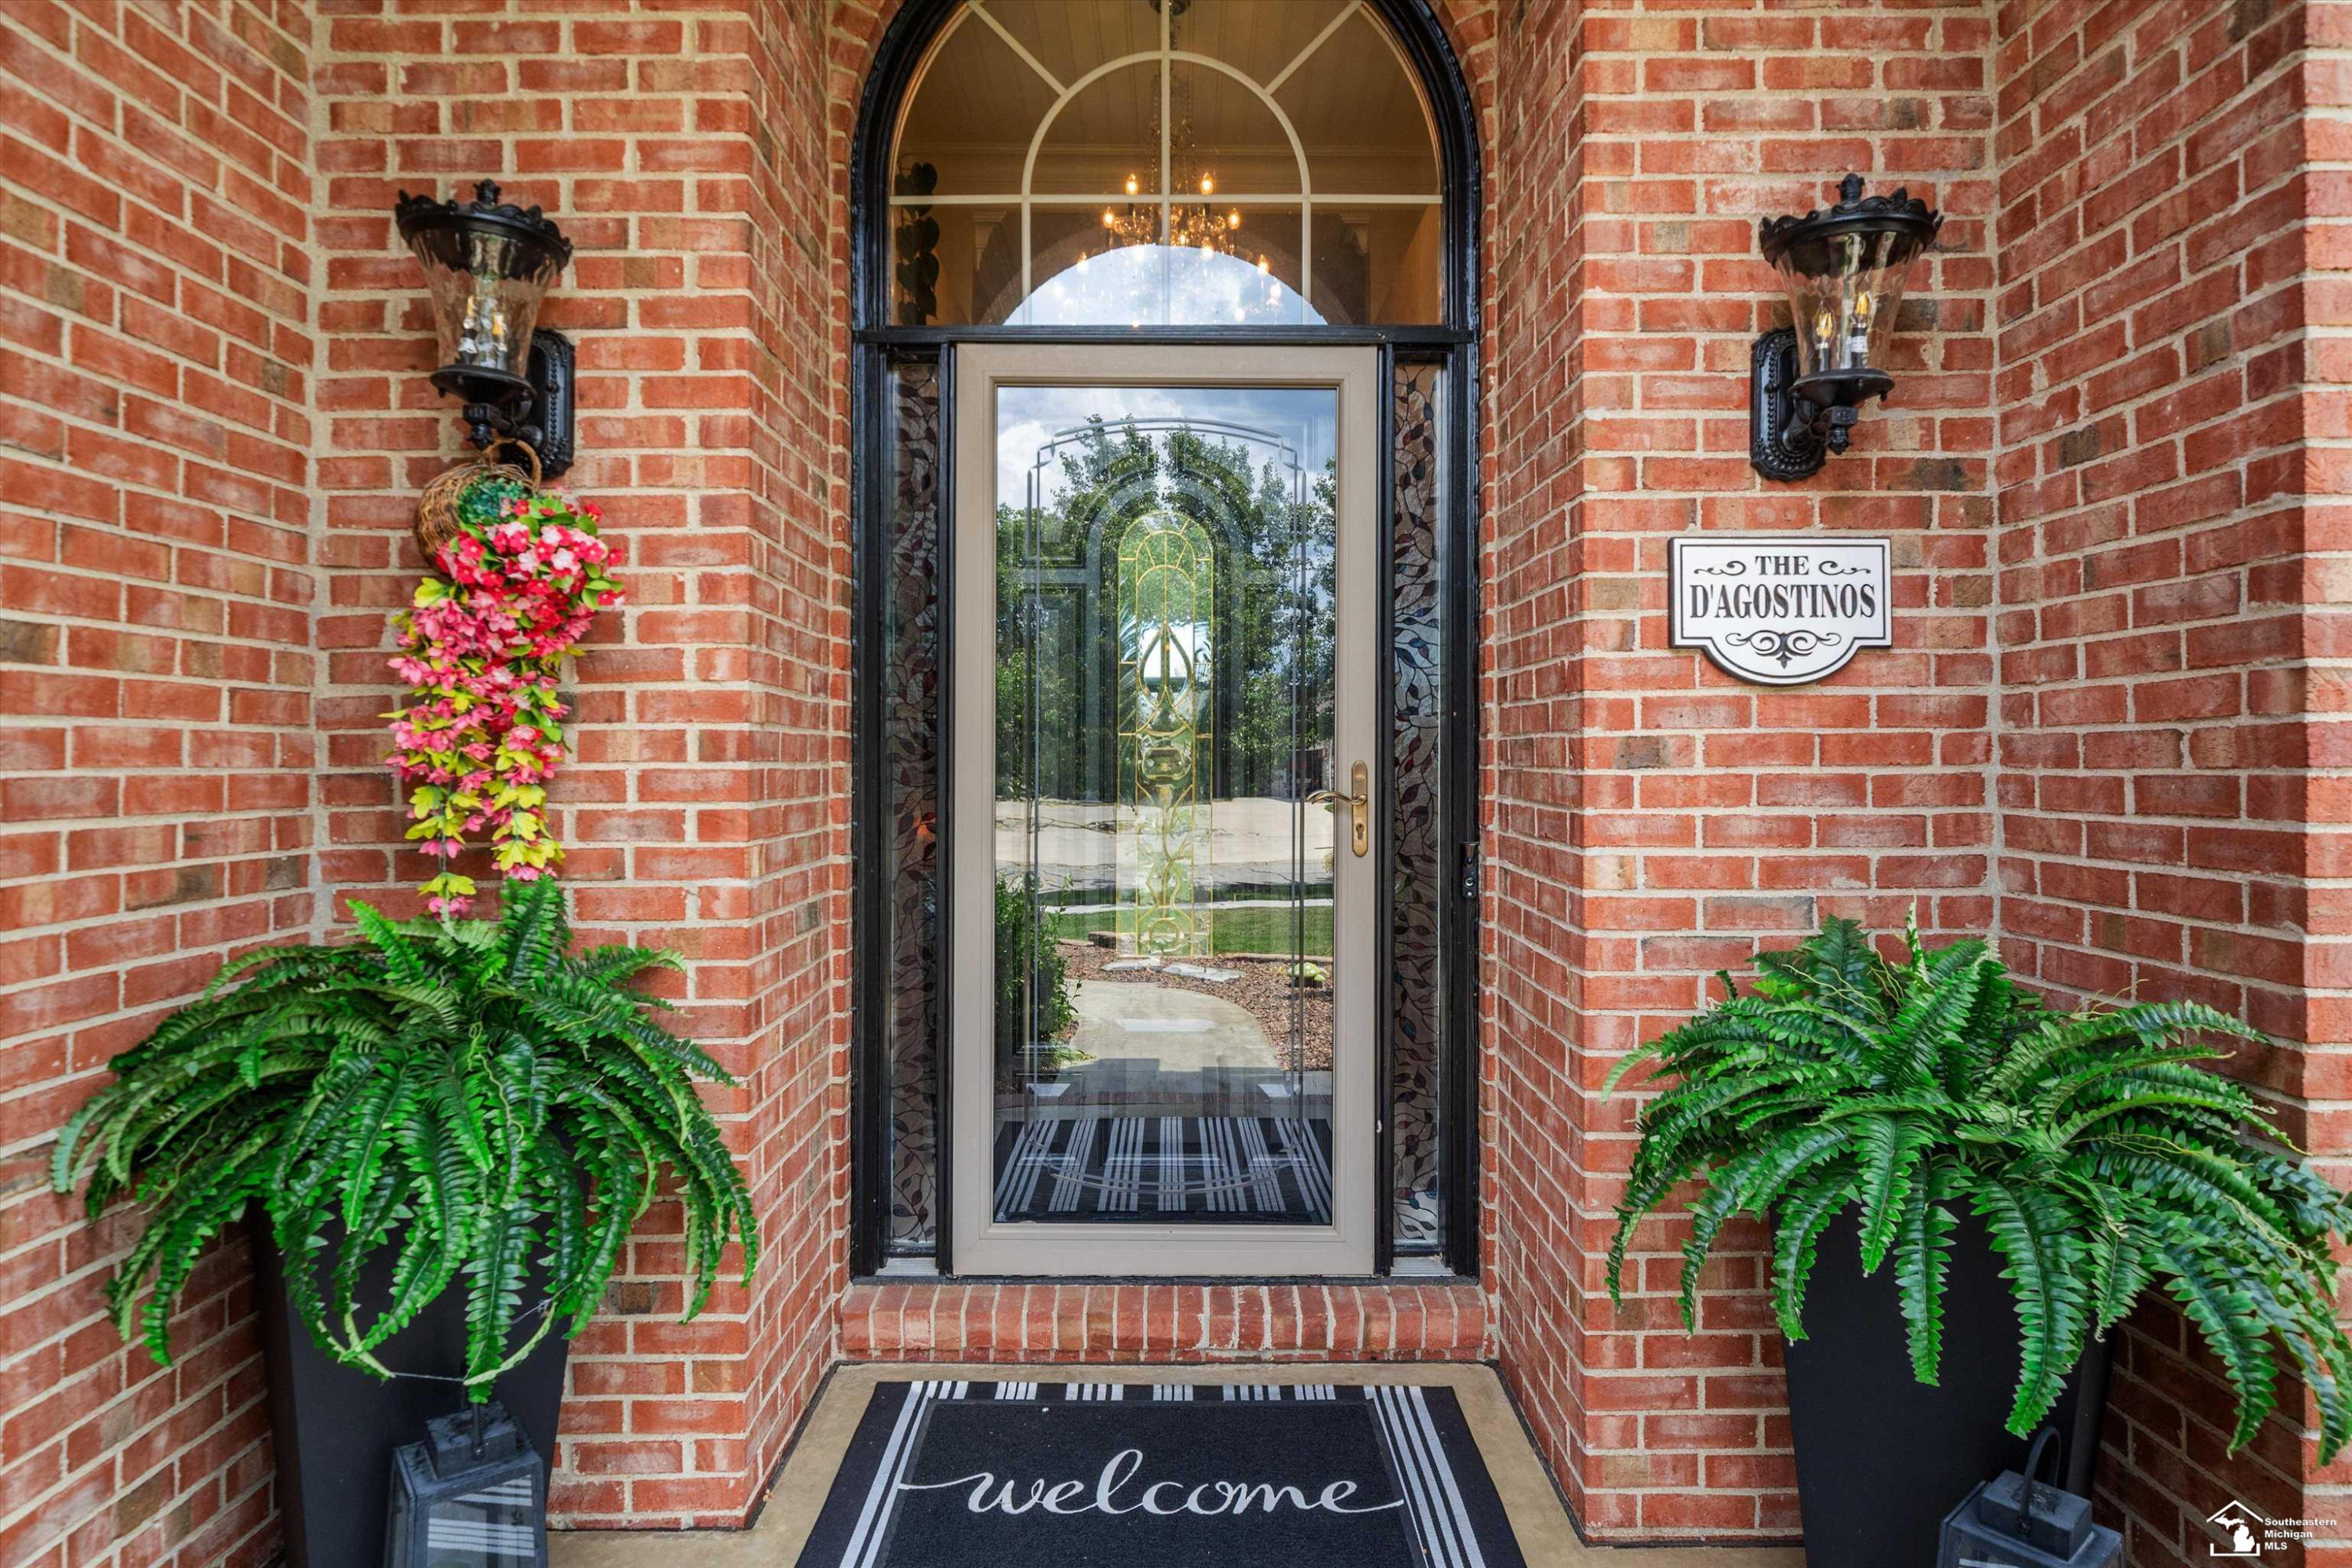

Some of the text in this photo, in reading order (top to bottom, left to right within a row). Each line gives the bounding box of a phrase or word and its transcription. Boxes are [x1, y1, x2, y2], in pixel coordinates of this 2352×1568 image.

[1755, 555, 1809, 575] THE
[1690, 583, 1875, 619] D'AGOSTINOS
[898, 1449, 1403, 1515] welcome
